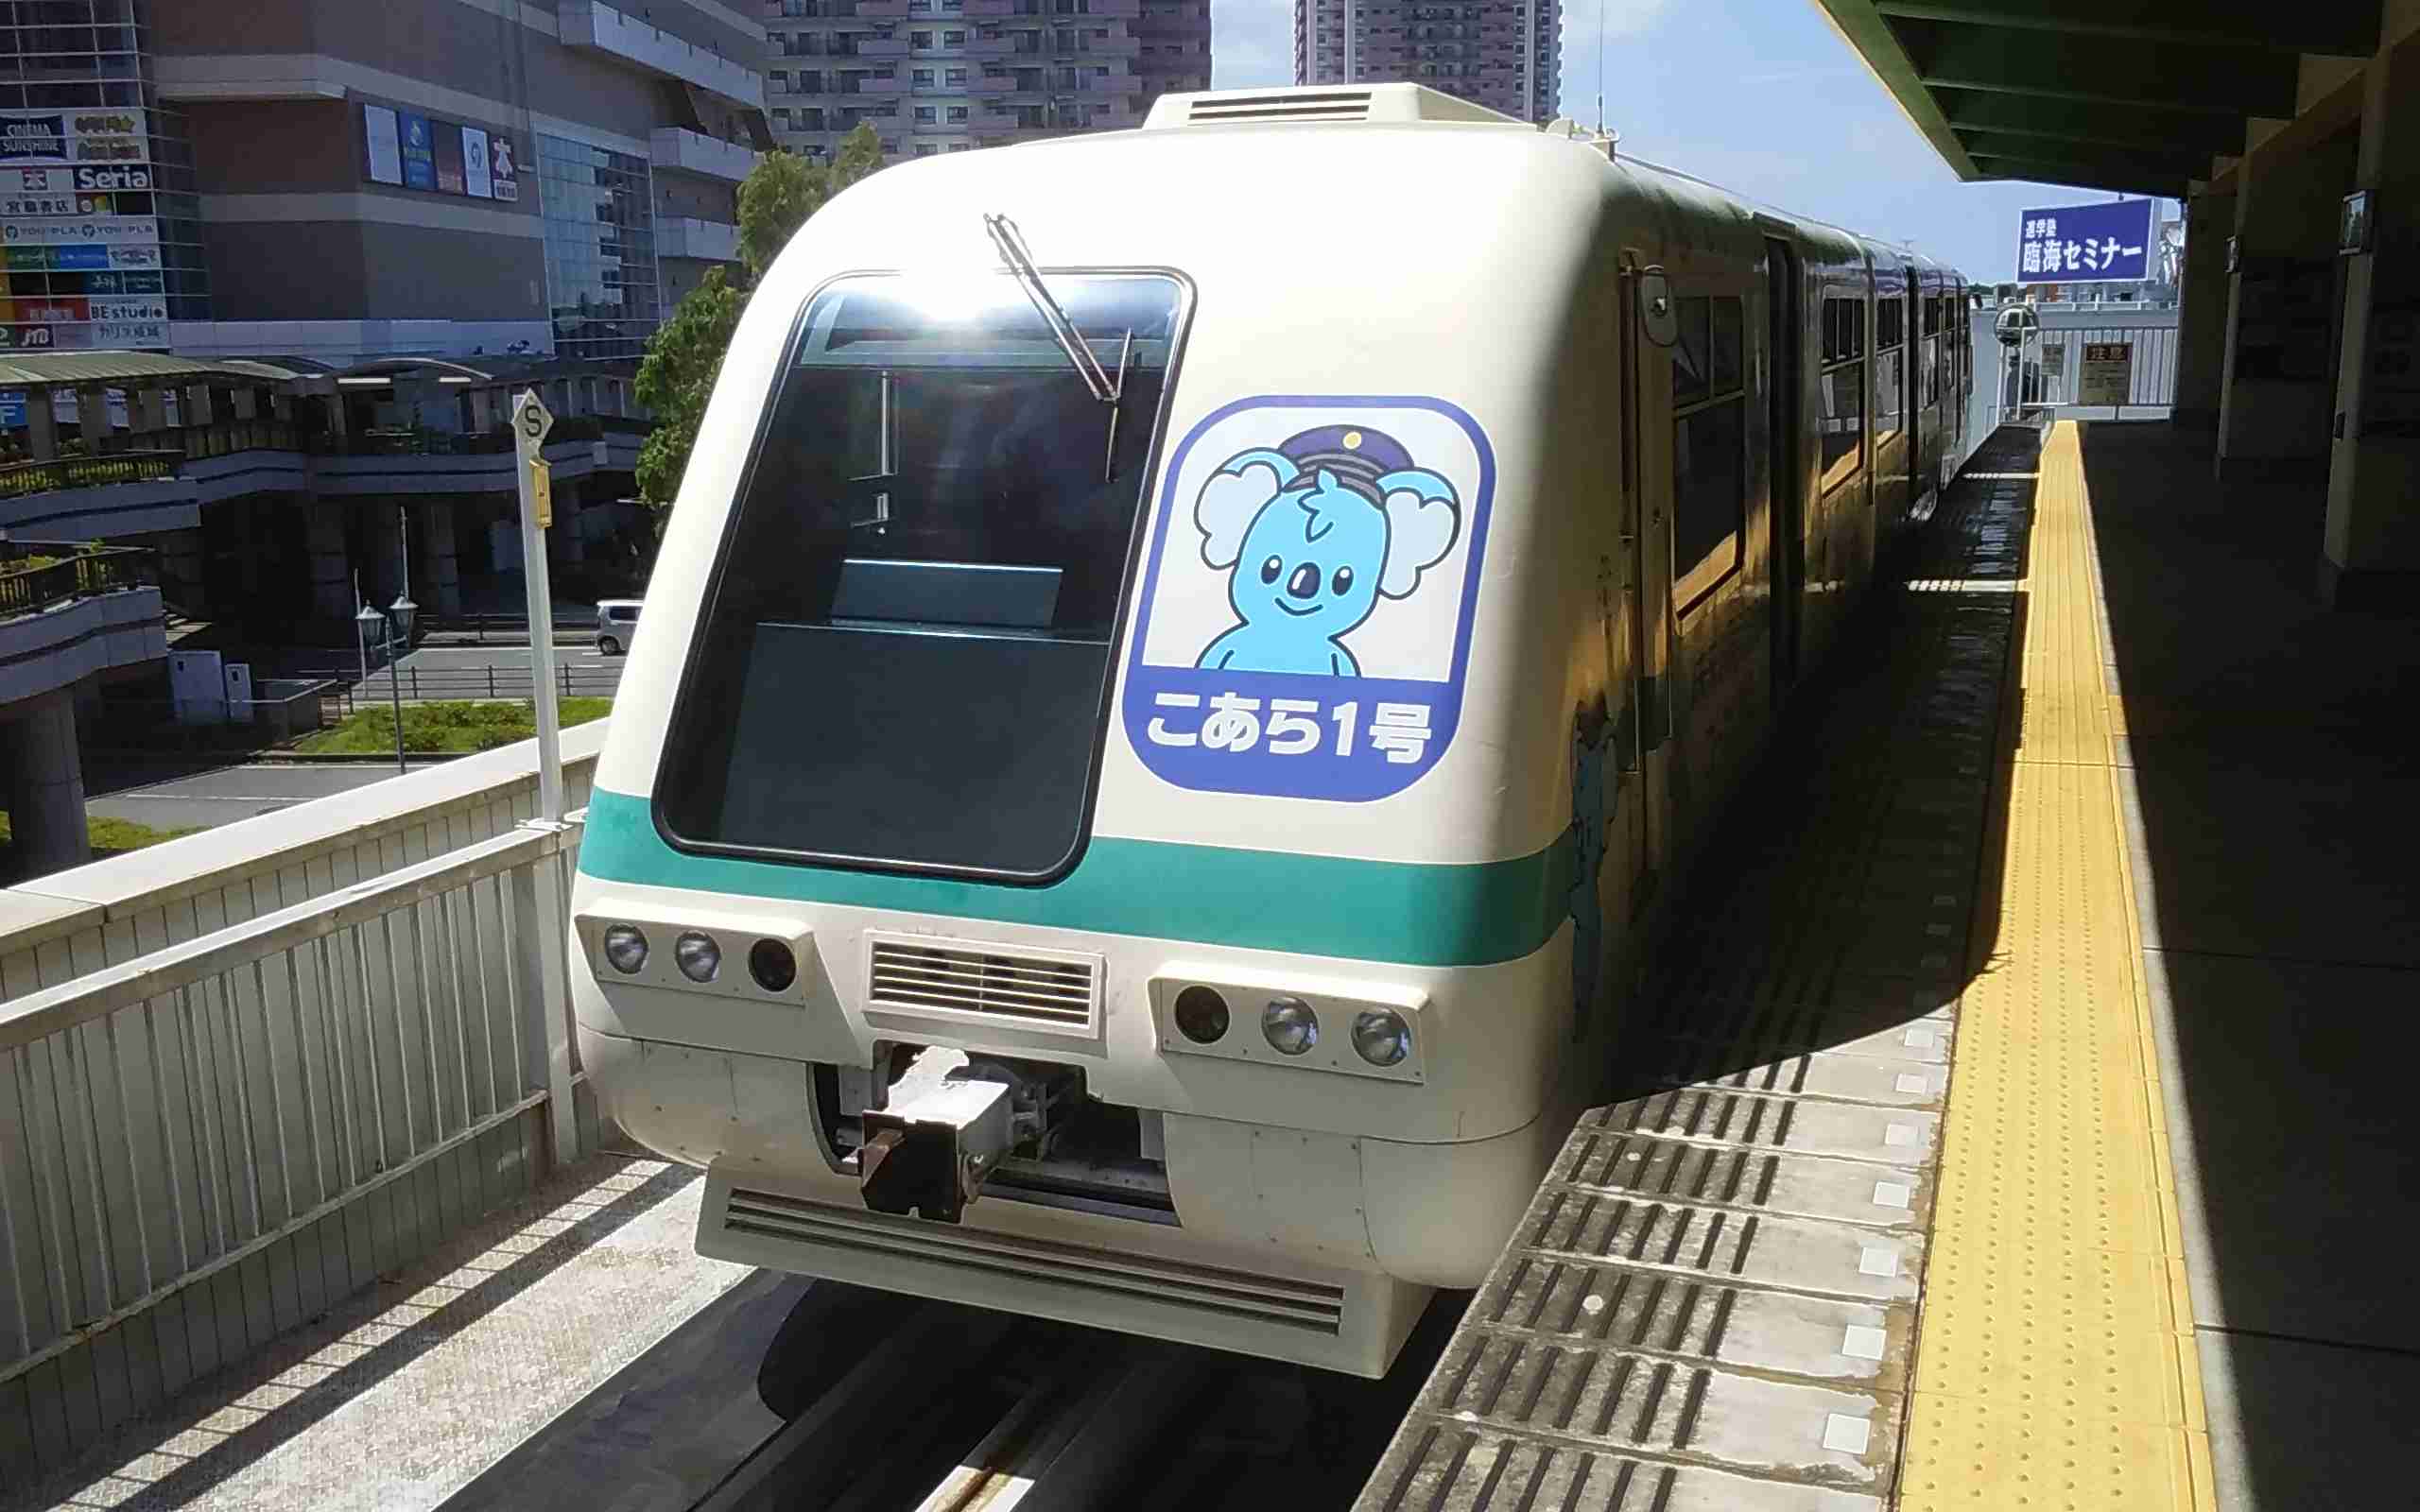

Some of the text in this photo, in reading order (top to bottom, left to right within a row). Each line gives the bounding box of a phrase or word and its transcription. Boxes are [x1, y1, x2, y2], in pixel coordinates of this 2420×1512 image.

[78, 165, 148, 189] Seria
[2022, 236, 2142, 273] 臨海セミナー
[112, 304, 164, 319] studio
[525, 405, 543, 437] S
[1148, 691, 1432, 765] こあら1号
